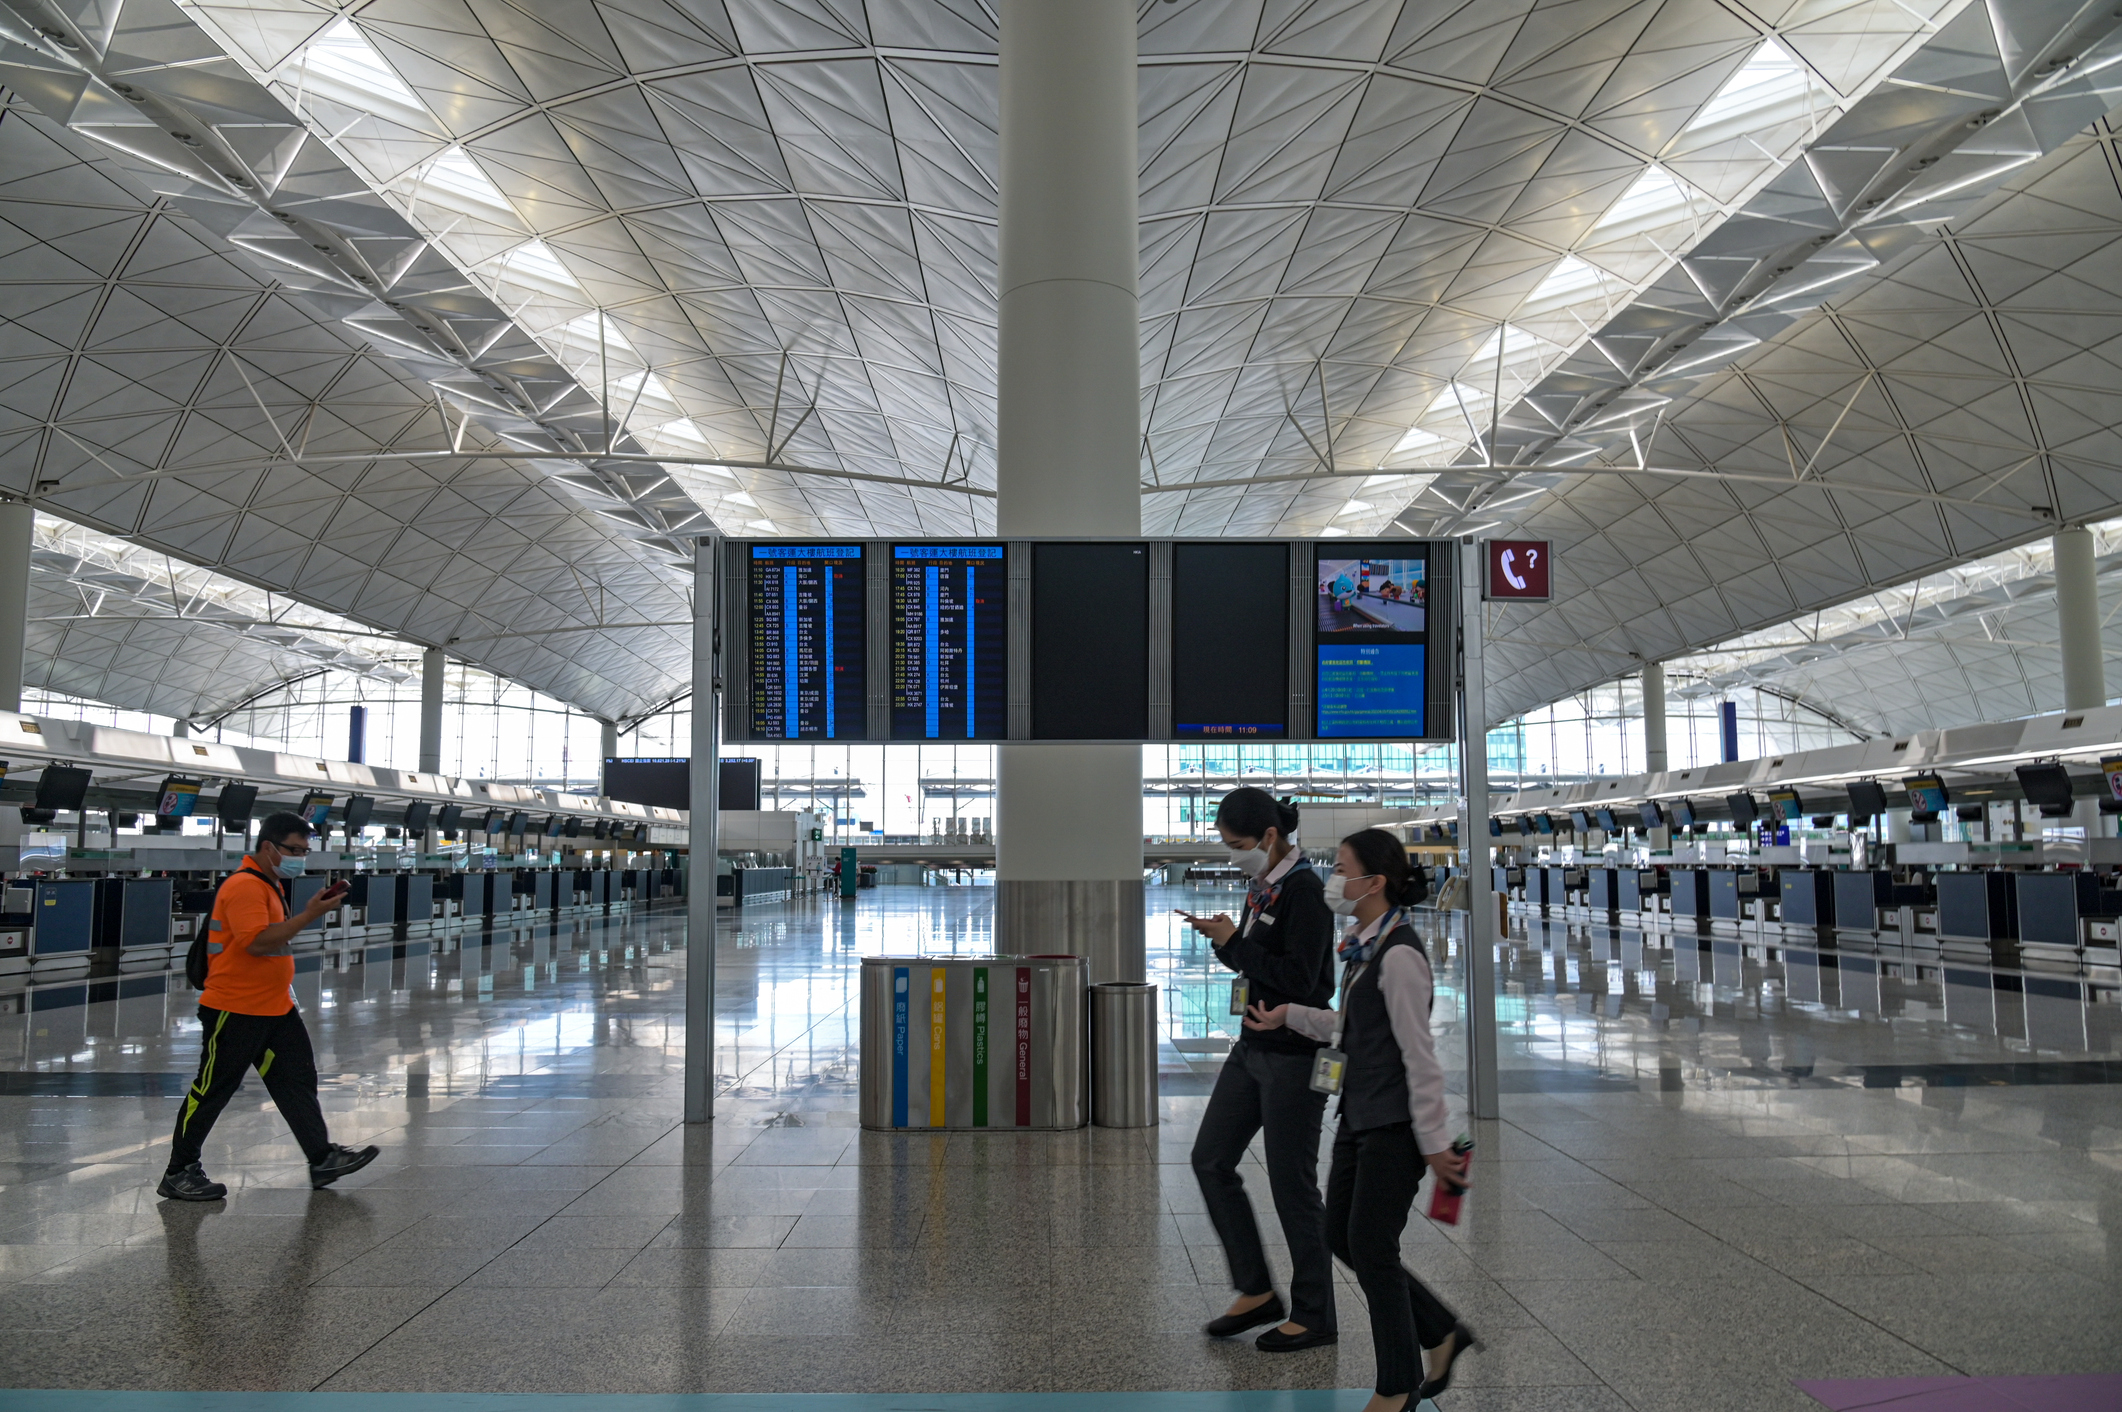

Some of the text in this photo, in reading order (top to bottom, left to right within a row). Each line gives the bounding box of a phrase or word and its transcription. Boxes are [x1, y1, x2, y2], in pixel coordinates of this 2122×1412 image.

[758, 548, 855, 557] 一號客運大樓航班登記
[900, 548, 997, 558] 一號客運大樓航班登記
[1202, 726, 1232, 734] 現在時間
[896, 1002, 906, 1056] 廢紙 Paper
[933, 1001, 944, 1050] 鋁罐 Cans
[975, 1001, 986, 1065] 膠樽 Plastics
[1018, 1000, 1029, 1080] 一般廢物 General
